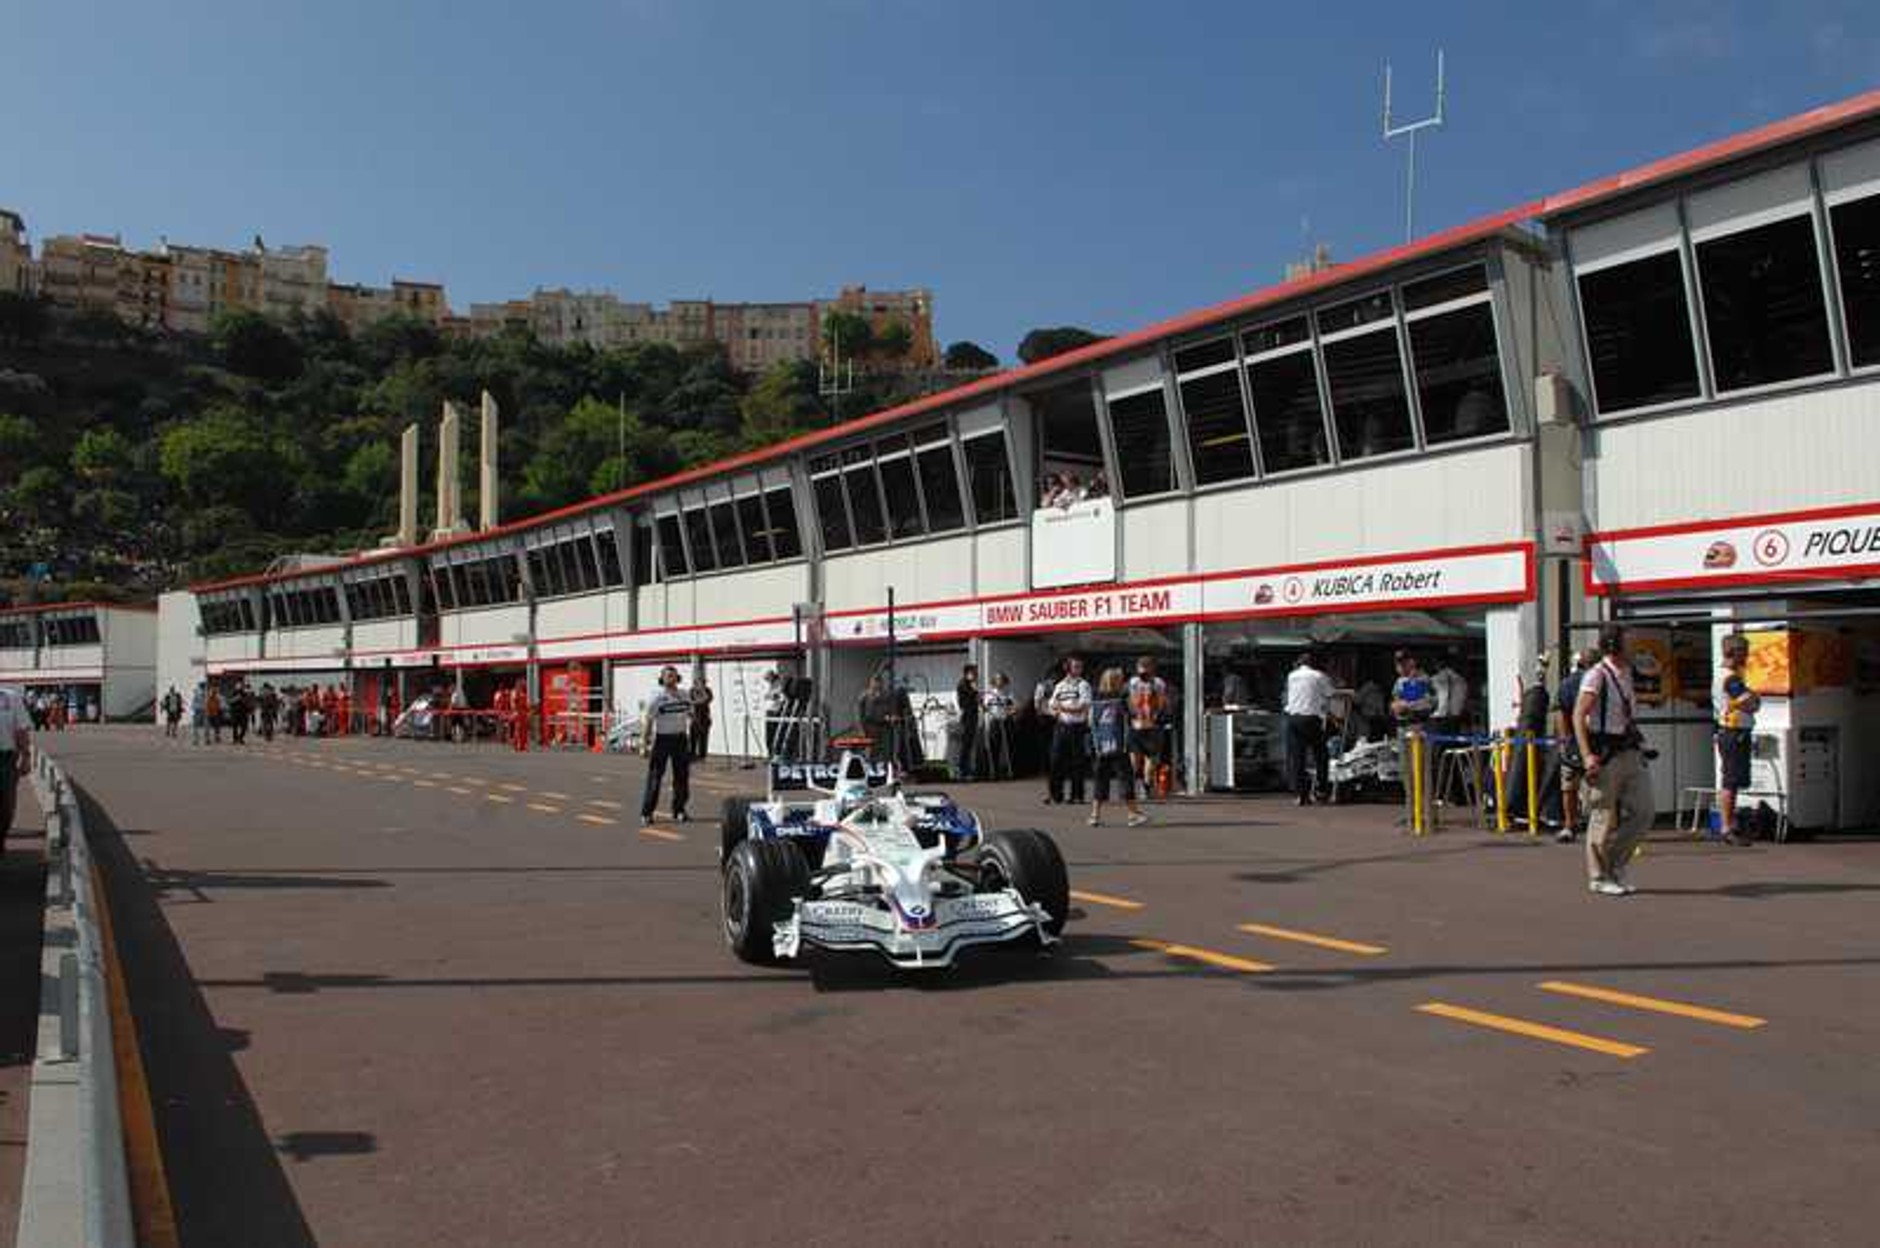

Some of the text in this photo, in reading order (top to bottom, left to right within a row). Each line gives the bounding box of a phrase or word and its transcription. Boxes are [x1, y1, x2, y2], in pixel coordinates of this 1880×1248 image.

[1764, 538, 1777, 558] 6
[1312, 575, 1374, 597] KUBICA
[1379, 570, 1442, 592] Robert
[987, 591, 1171, 624] BMW SAUBER F1 TEAM
